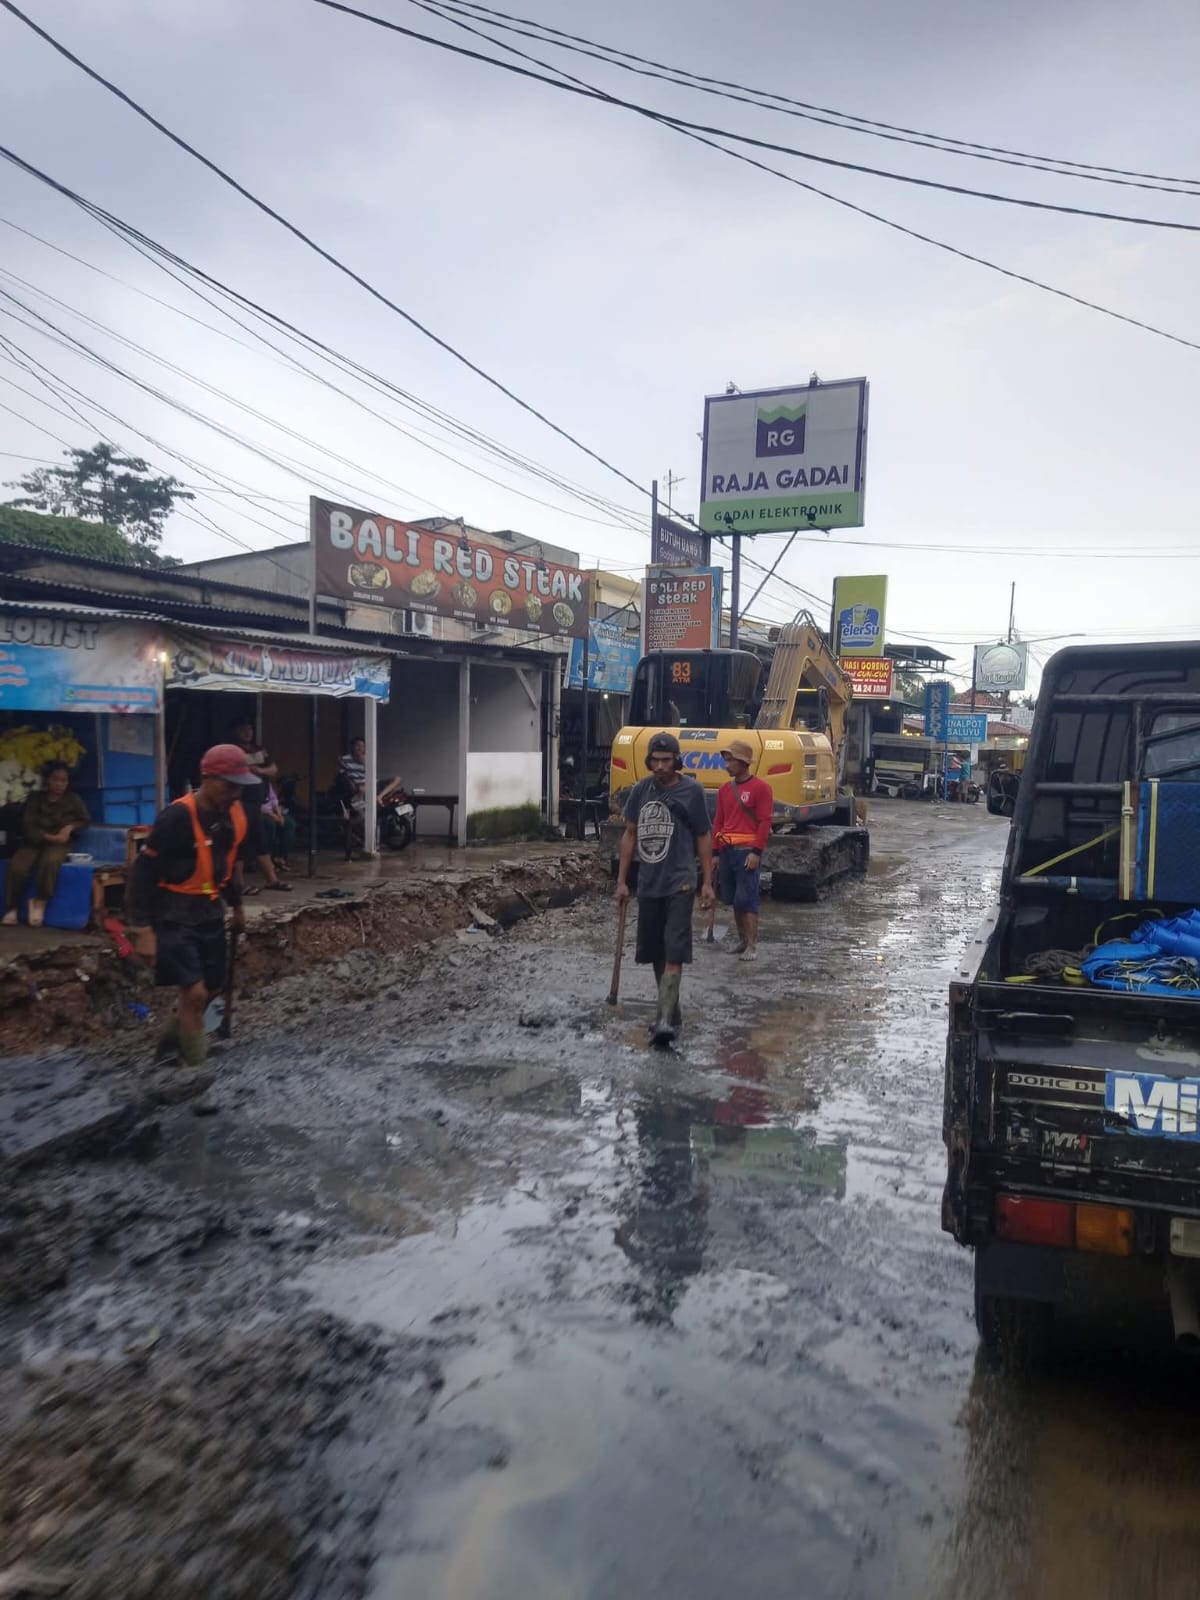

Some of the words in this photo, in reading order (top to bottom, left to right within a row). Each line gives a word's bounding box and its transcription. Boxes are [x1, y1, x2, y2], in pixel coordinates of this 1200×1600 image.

[767, 429, 795, 448] RG
[711, 471, 769, 494] RAJA
[776, 464, 849, 489] GADAI
[714, 509, 755, 521] GADAI
[759, 503, 843, 519] ELEKTRONIK
[328, 510, 421, 567] BALI
[433, 538, 493, 582] RED
[503, 556, 583, 601] STEAK
[682, 580, 706, 592] RED
[0, 617, 98, 650] LORIST
[671, 661, 692, 677] 83
[843, 661, 860, 670] NASI
[860, 661, 890, 671] GORENG
[1009, 1073, 1070, 1090] DOHC
